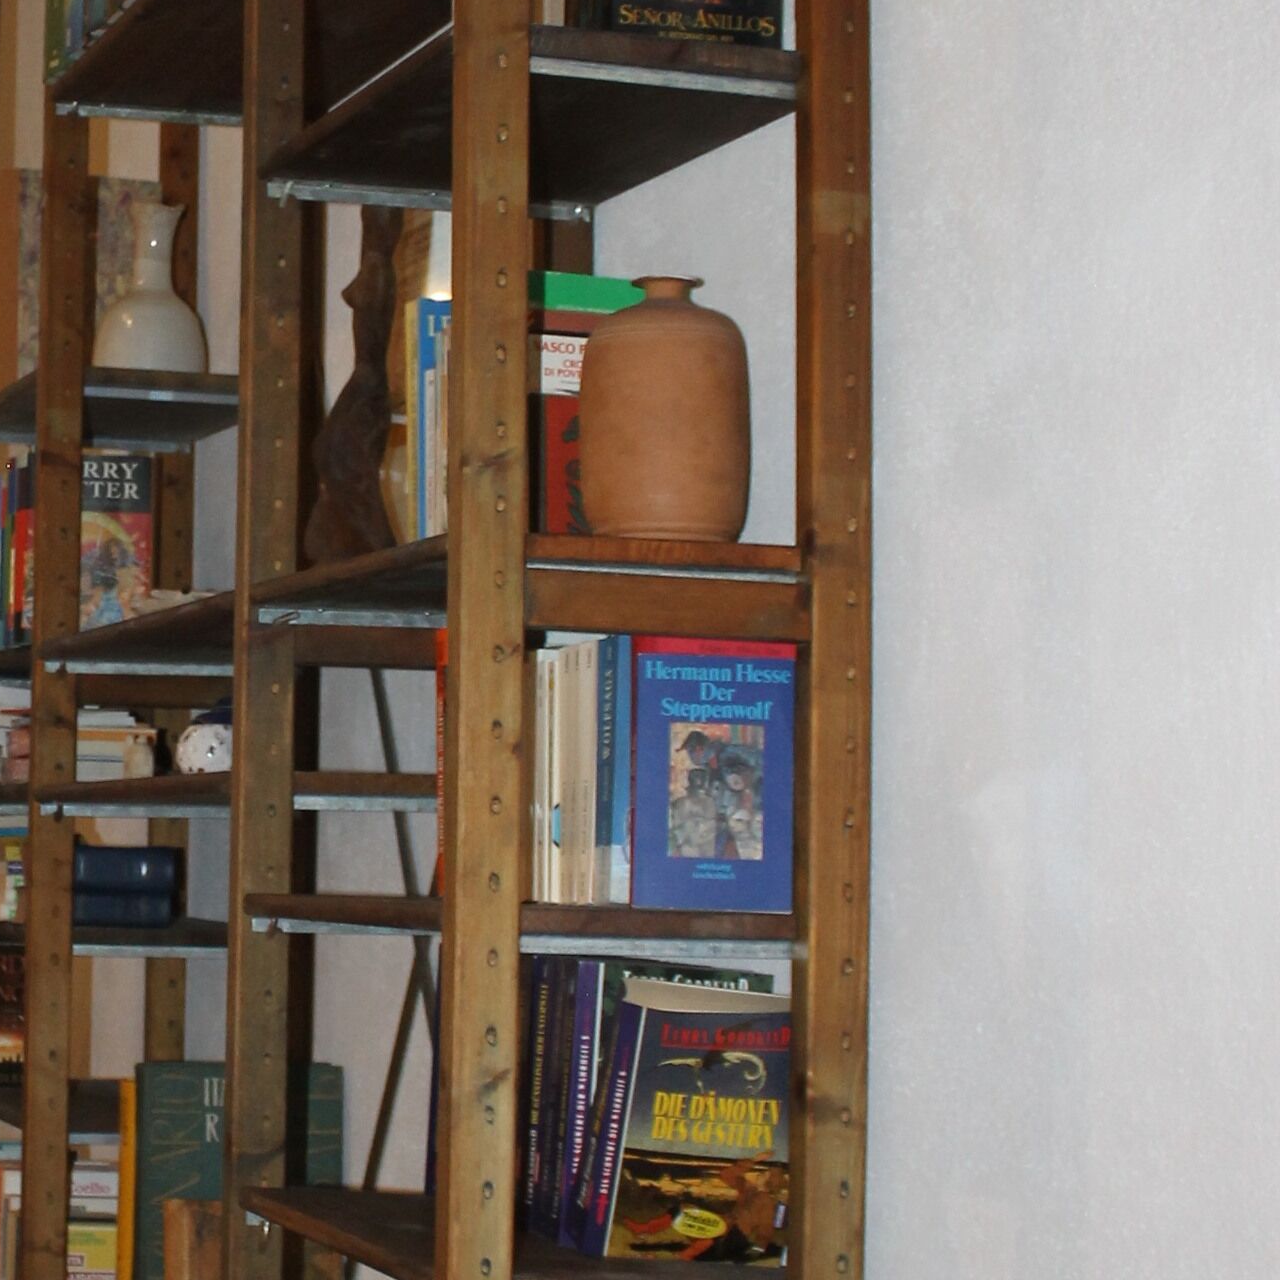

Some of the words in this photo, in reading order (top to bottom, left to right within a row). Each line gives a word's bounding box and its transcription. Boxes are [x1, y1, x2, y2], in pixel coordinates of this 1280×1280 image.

[619, 4, 686, 31] SEÑOR
[692, 9, 776, 38] ANILLOS
[82, 460, 139, 480] RRY
[644, 660, 732, 682] Hermann
[735, 663, 792, 685] Hesse
[700, 682, 736, 702] Der
[660, 697, 773, 722] Steppenwolf
[715, 1026, 791, 1048] GOODKIND
[652, 1090, 688, 1117] DIE
[689, 1090, 781, 1126] DÄMONEN
[651, 1116, 688, 1142] DES
[690, 1120, 775, 1150] GESTERN
